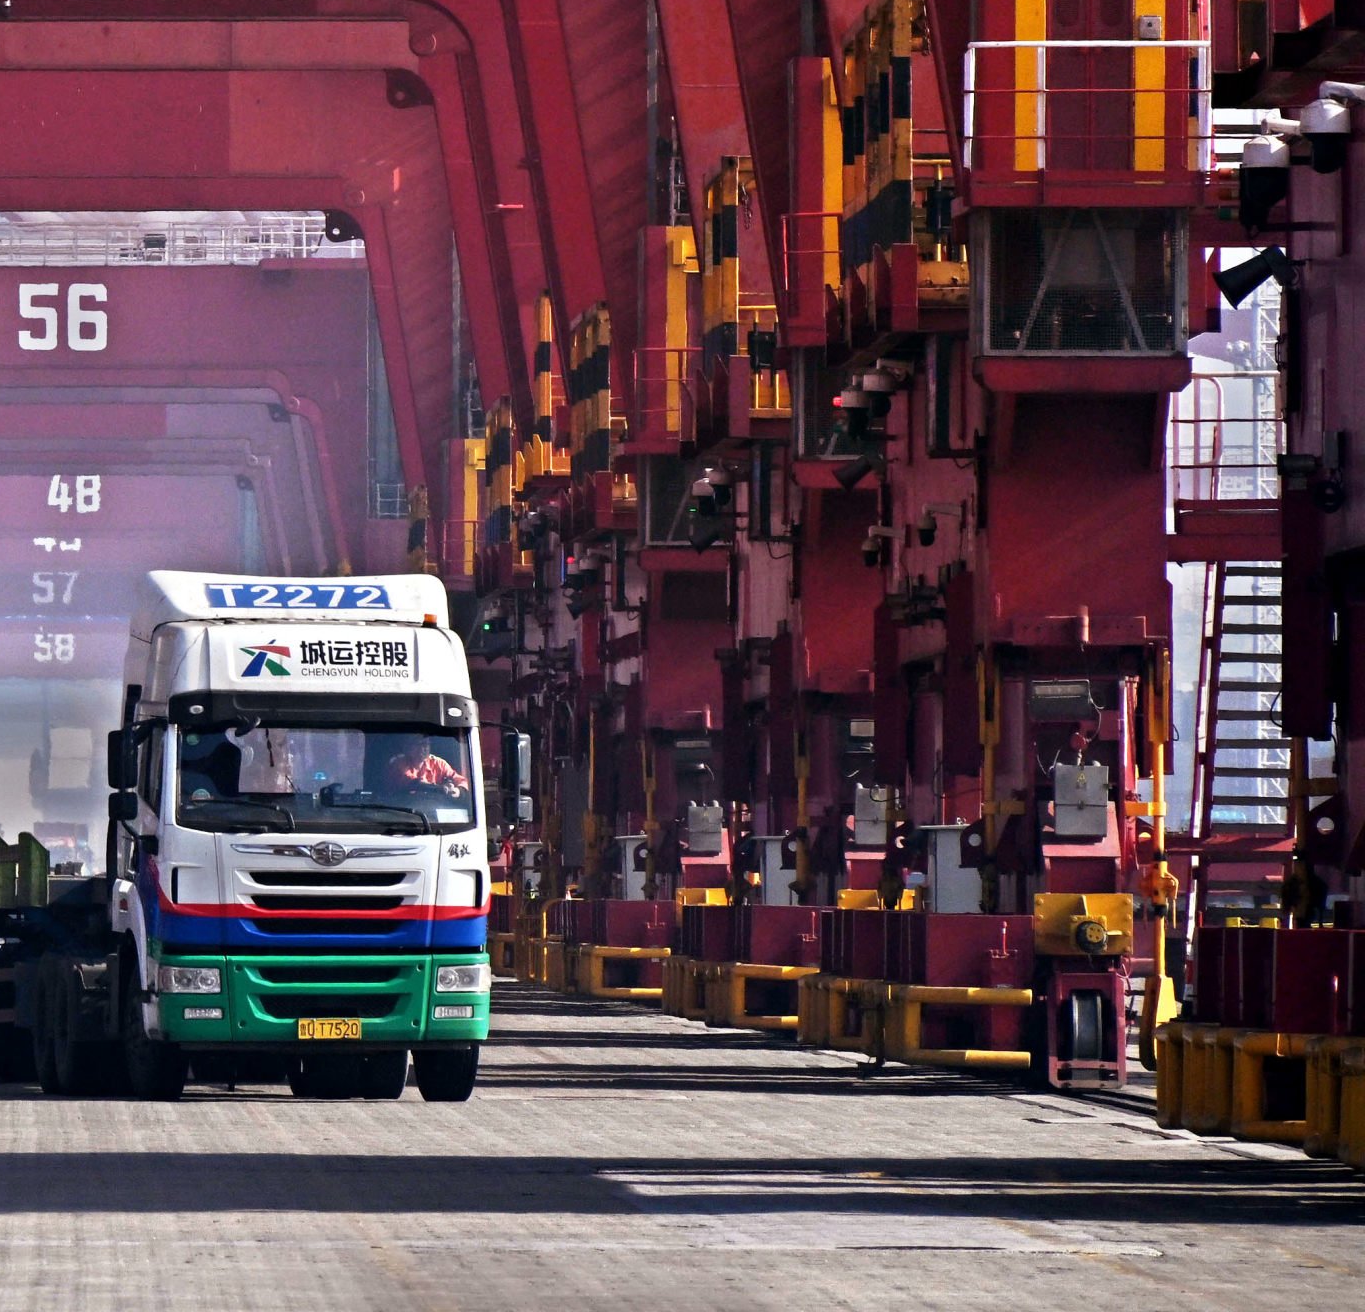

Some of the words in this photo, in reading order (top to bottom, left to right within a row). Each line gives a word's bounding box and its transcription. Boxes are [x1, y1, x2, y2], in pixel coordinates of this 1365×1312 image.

[19, 284, 107, 350] 56
[47, 475, 101, 513] 48
[32, 572, 79, 604] 57
[209, 584, 386, 608] T2272
[33, 633, 75, 663] 58
[300, 641, 409, 667] 城运控股
[301, 668, 358, 677] CHENGYUN
[365, 669, 409, 678] HOLDING
